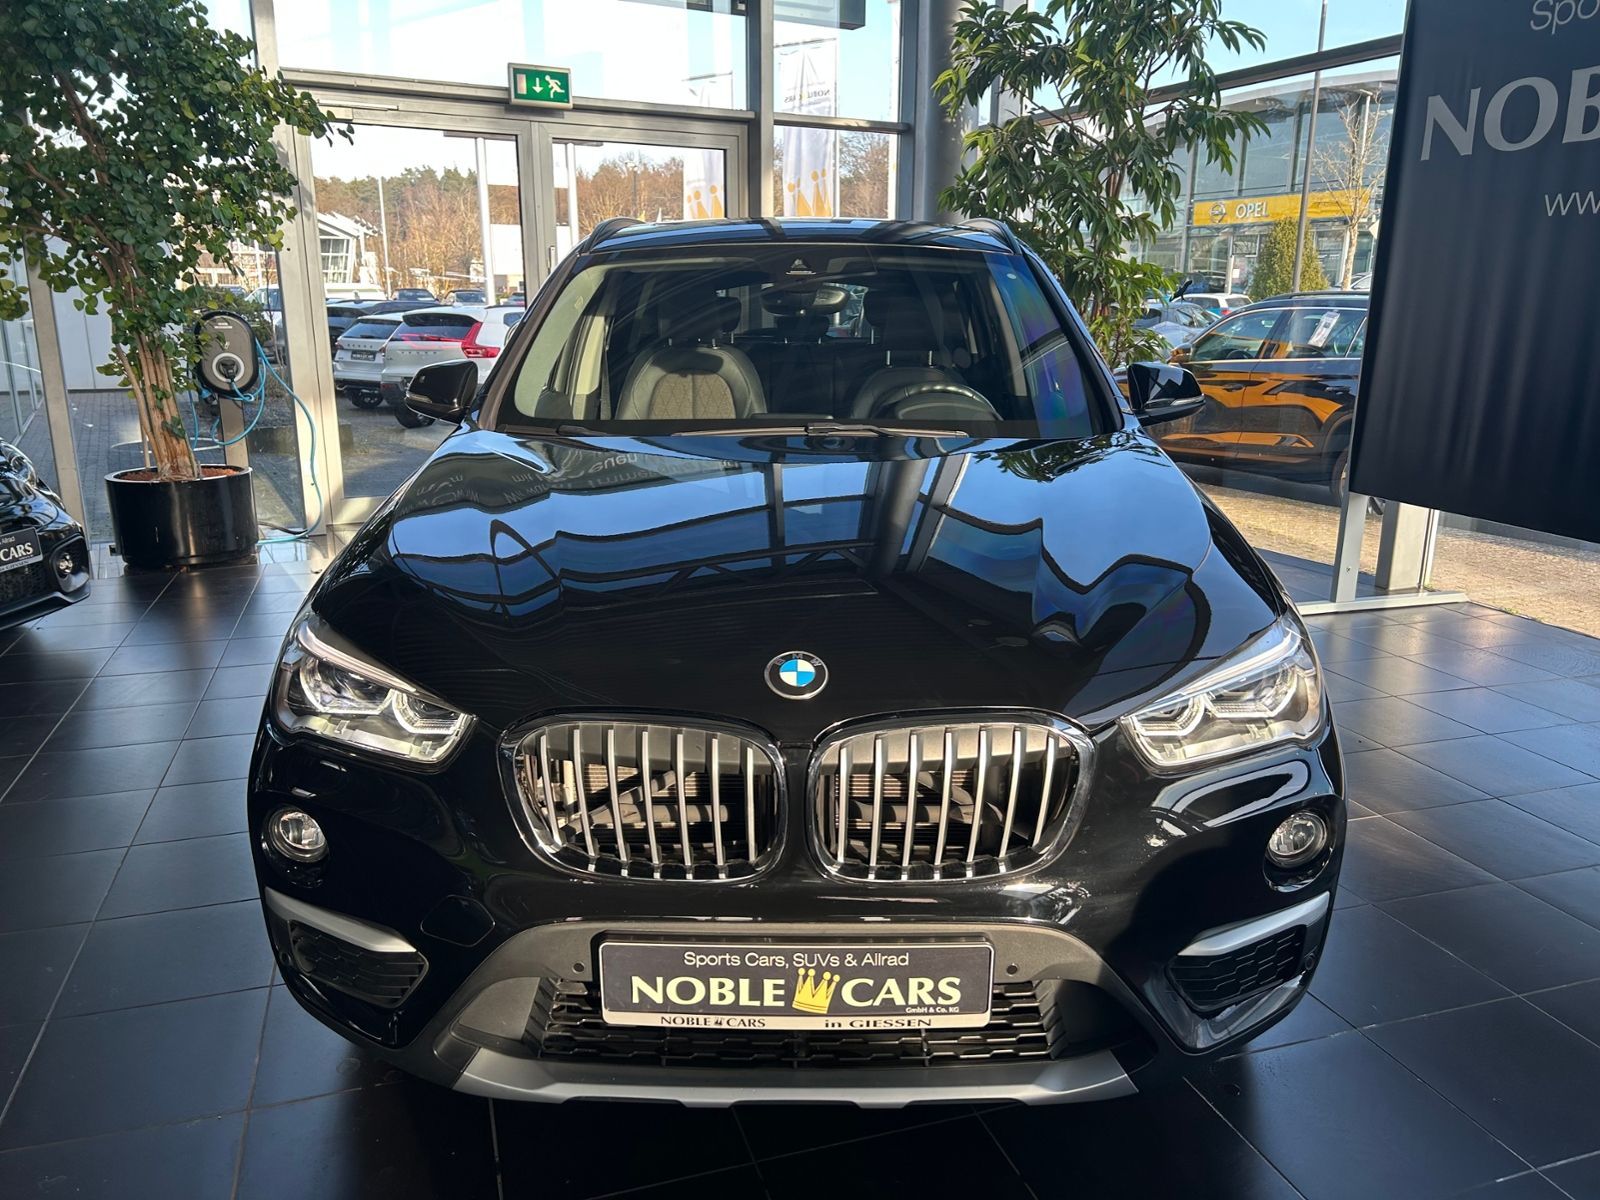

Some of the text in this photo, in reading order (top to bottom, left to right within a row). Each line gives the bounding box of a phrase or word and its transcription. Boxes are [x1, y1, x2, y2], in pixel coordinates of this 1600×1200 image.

[1530, 0, 1600, 35] Spo
[1420, 65, 1600, 161] NOB
[1236, 201, 1269, 219] OPEL
[0, 542, 34, 561] CARS
[775, 653, 822, 667] BMW
[683, 951, 909, 969] Sports Cars, SUVs & Allrad
[631, 975, 962, 1007] NOBLE CARS
[905, 1006, 928, 1014] GmbH
[935, 1006, 948, 1014] Co.
[660, 1016, 932, 1028] NOBLE CARS in GIESSEN
